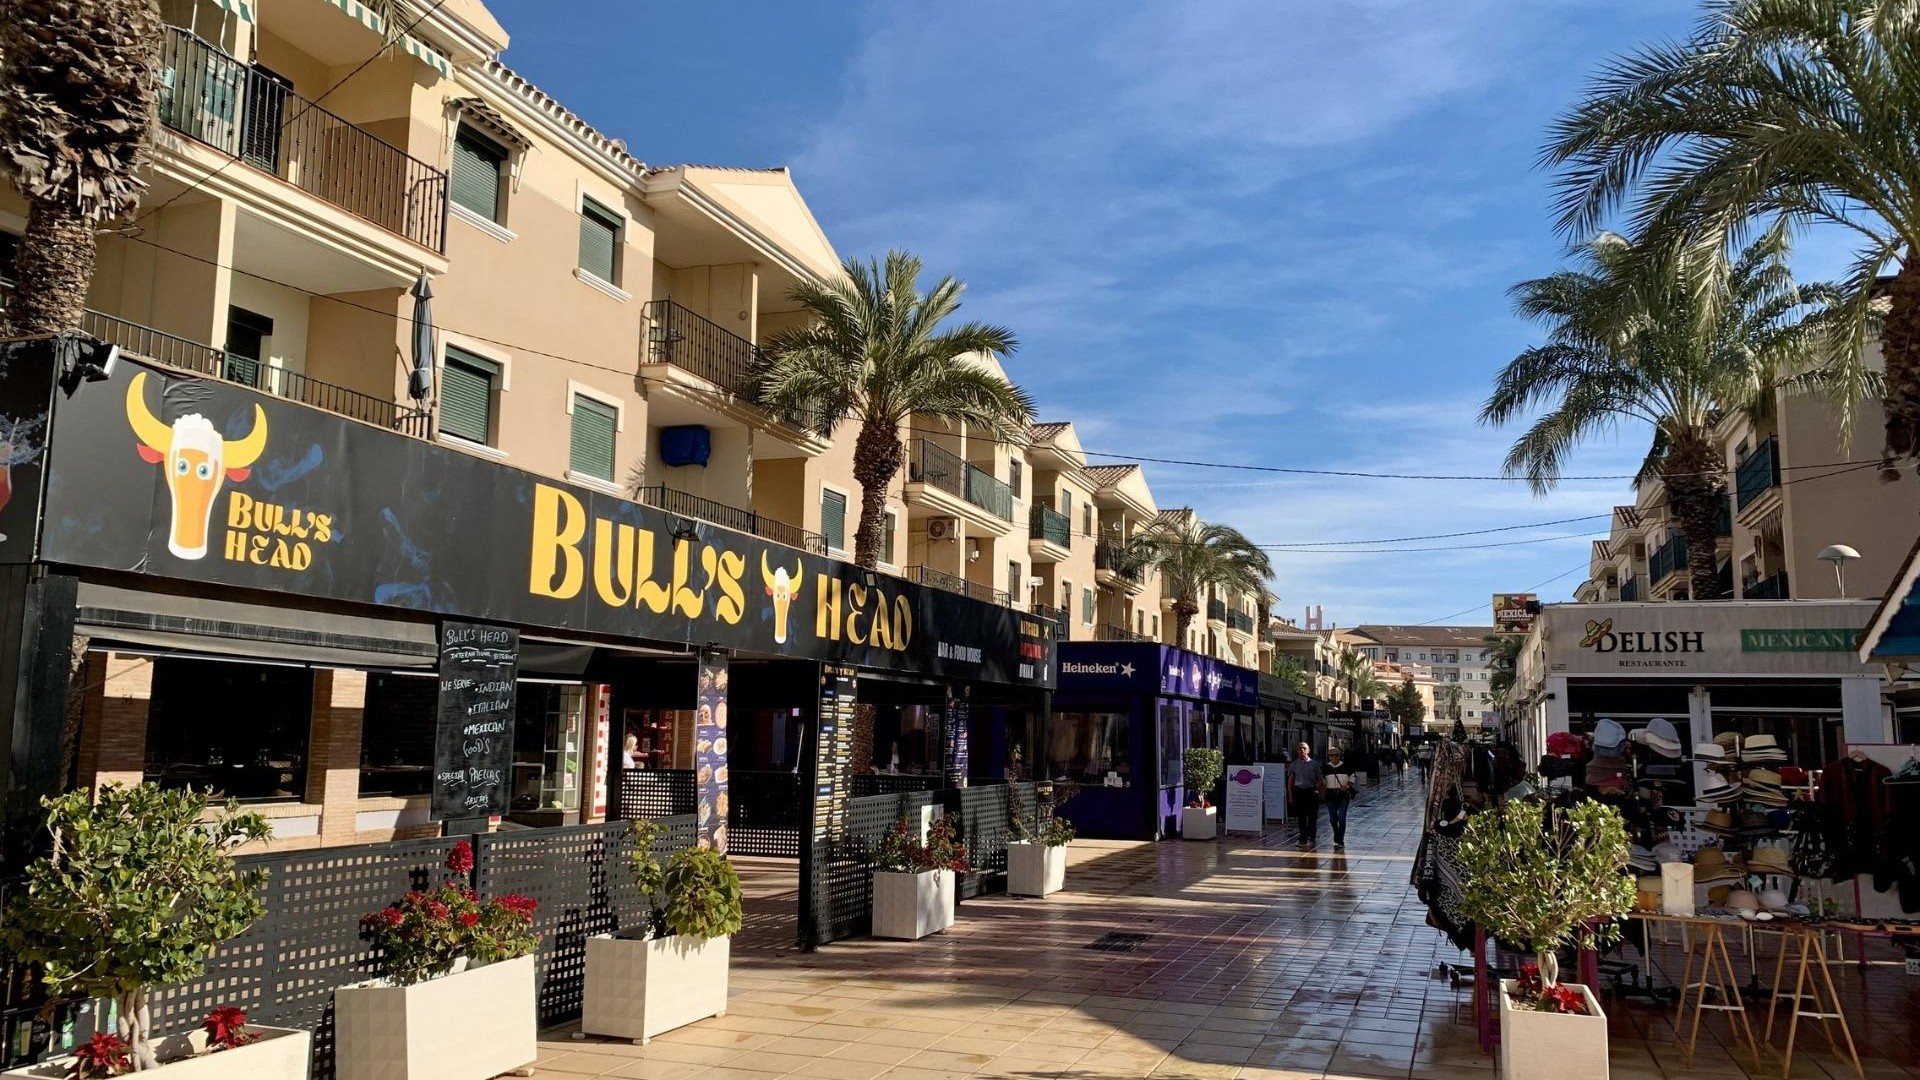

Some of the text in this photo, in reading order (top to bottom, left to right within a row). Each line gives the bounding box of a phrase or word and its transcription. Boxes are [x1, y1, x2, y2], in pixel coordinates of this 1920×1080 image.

[228, 490, 332, 543] BULL'S
[225, 530, 312, 571] HEAD
[530, 483, 912, 652] BULL'S HEAD
[480, 629, 509, 644] HEAD
[1595, 630, 1705, 653] DELISH
[1749, 631, 1845, 649] MEXICAN
[954, 644, 967, 661] FOOD
[966, 646, 982, 664] HOUSE
[1618, 659, 1687, 668] RESTAURANTE
[1062, 662, 1118, 674] Heineken
[441, 681, 452, 692] WE
